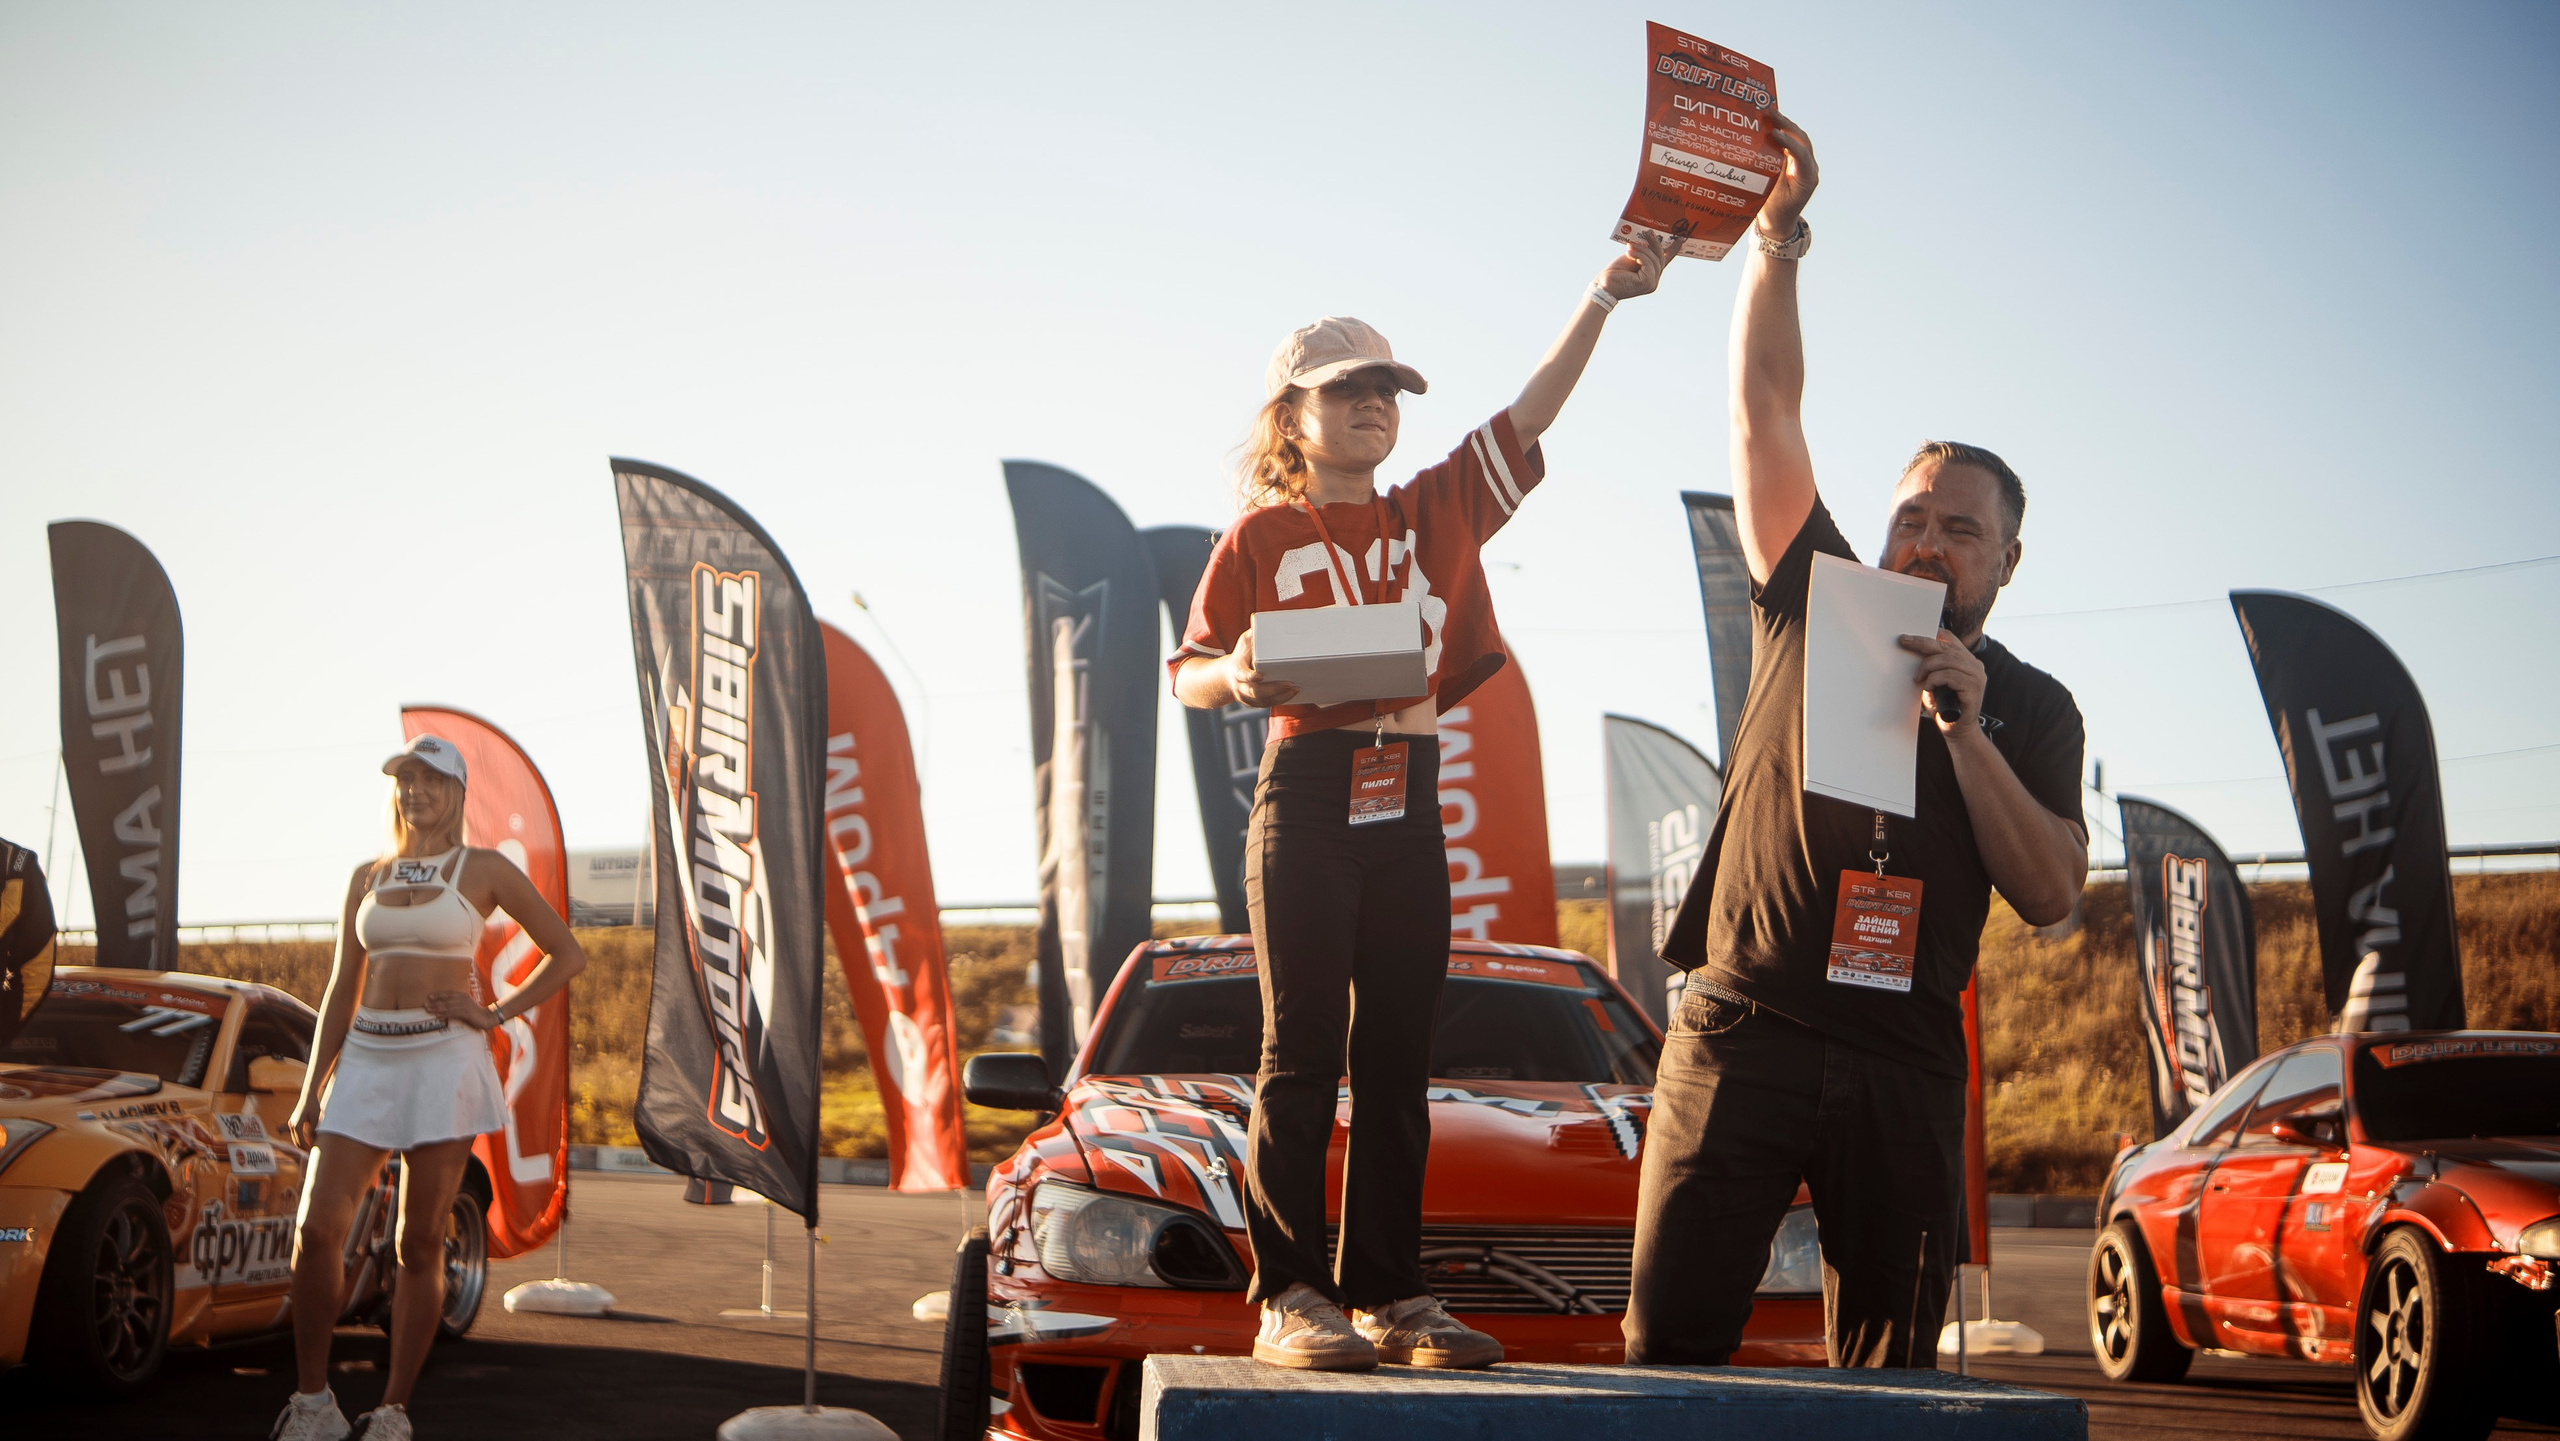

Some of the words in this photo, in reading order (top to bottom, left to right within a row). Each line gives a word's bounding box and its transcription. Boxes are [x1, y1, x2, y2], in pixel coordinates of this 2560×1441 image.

[1656, 55, 1721, 90] DRIFT
[1721, 76, 1771, 109] LETO
[1648, 120, 1657, 130] В
[1673, 94, 1760, 132] ДИПЛОМ
[1679, 115, 1697, 129] ЗА
[1699, 122, 1753, 145] УЧАСТИЕ
[1659, 175, 1690, 192] DRIFT
[1690, 183, 1717, 200] LETO
[85, 632, 152, 776] НЕТ
[1361, 778, 1396, 790] ПИЛОТ
[2306, 708, 2395, 856] НЕТ
[692, 566, 768, 1140] SIBIRMOTORS
[1853, 922, 1901, 936] ЕВГЕНИЙ
[1857, 914, 1899, 928] ЗАЙЦЕВ
[1858, 935, 1893, 945] ВЕДУЩИЙ
[2391, 1042, 2478, 1062] DRIFT
